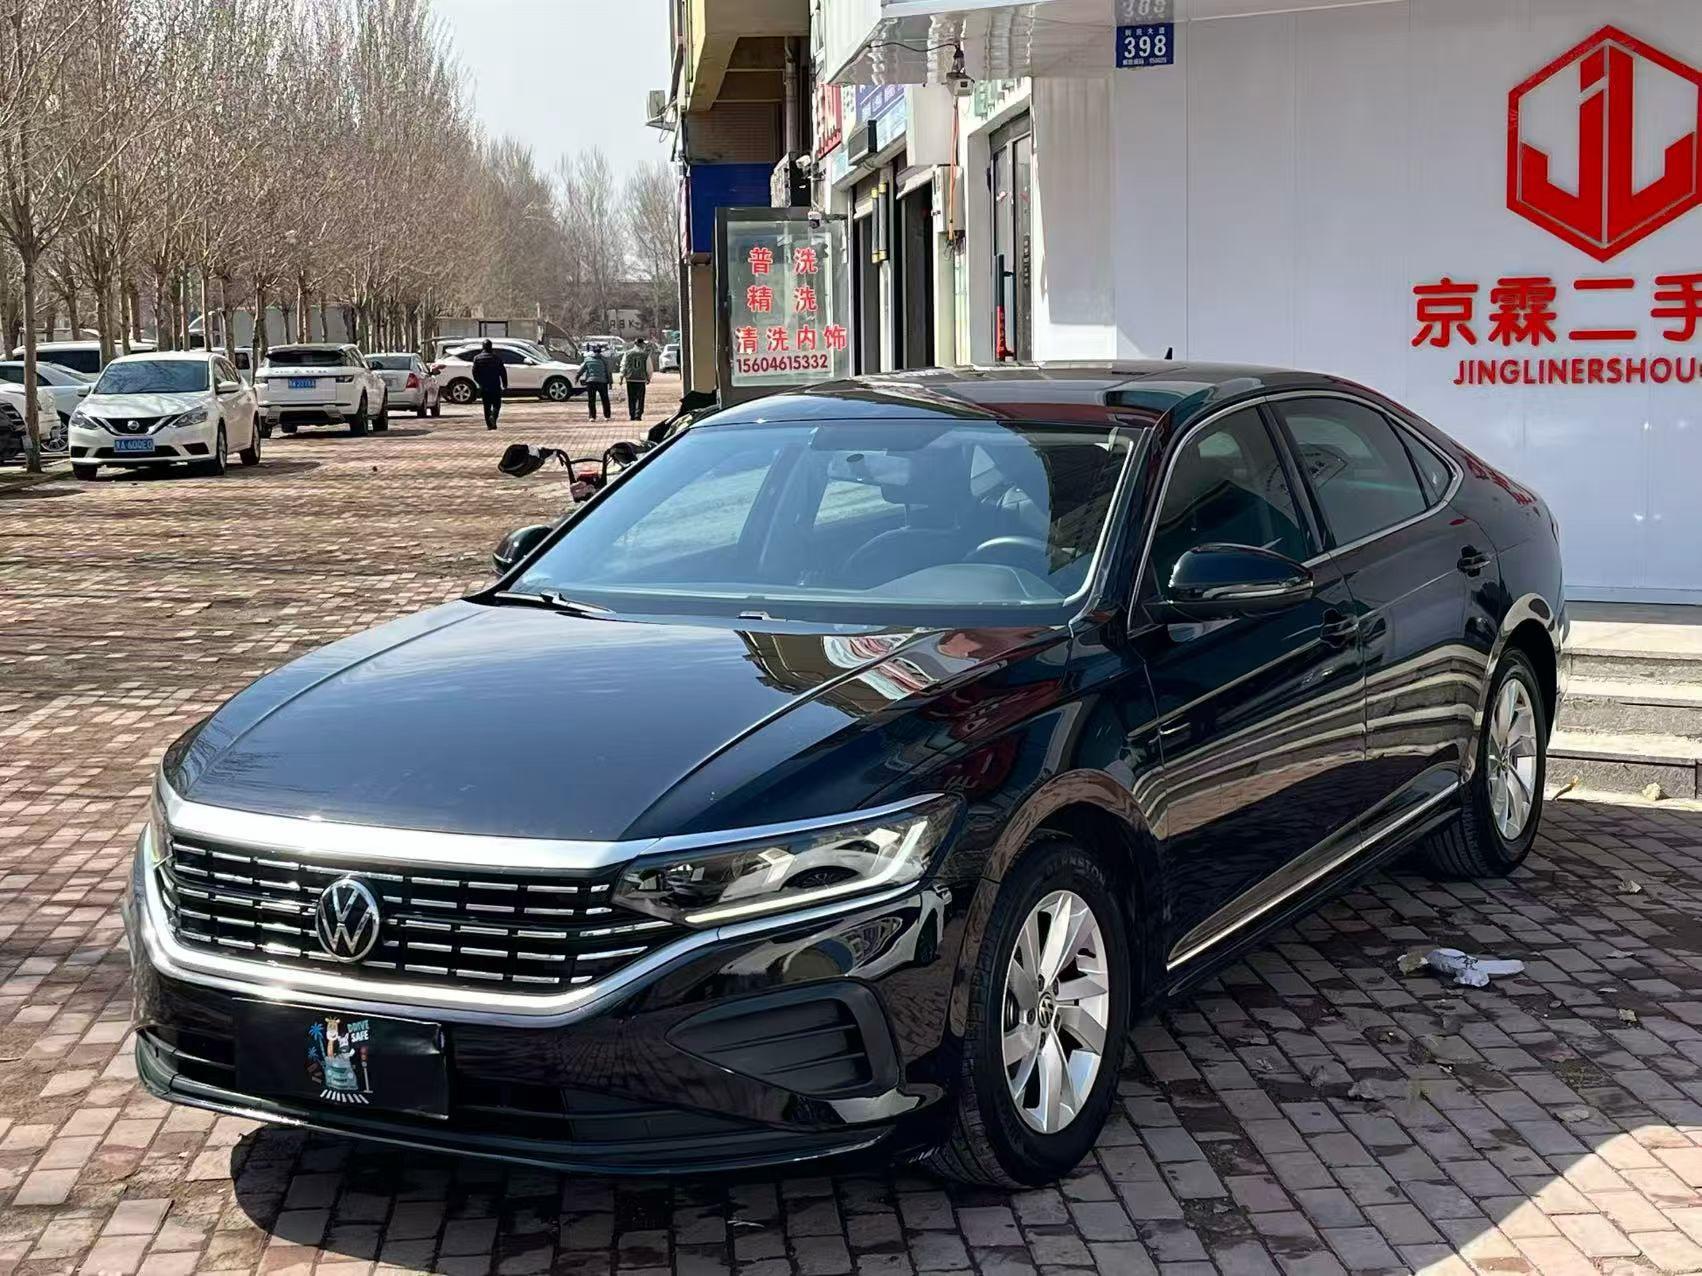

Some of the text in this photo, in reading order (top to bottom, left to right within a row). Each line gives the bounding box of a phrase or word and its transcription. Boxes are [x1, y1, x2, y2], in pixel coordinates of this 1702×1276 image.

[1124, 35, 1166, 58] 398
[1411, 273, 1702, 348] 京霖二手
[735, 324, 847, 354] 清洗内饰
[736, 354, 828, 373] 15604615332
[1453, 357, 1702, 385] JINGLINERSHOU
[347, 1019, 370, 1032] DRIVE
[351, 1030, 370, 1043] SAFE
